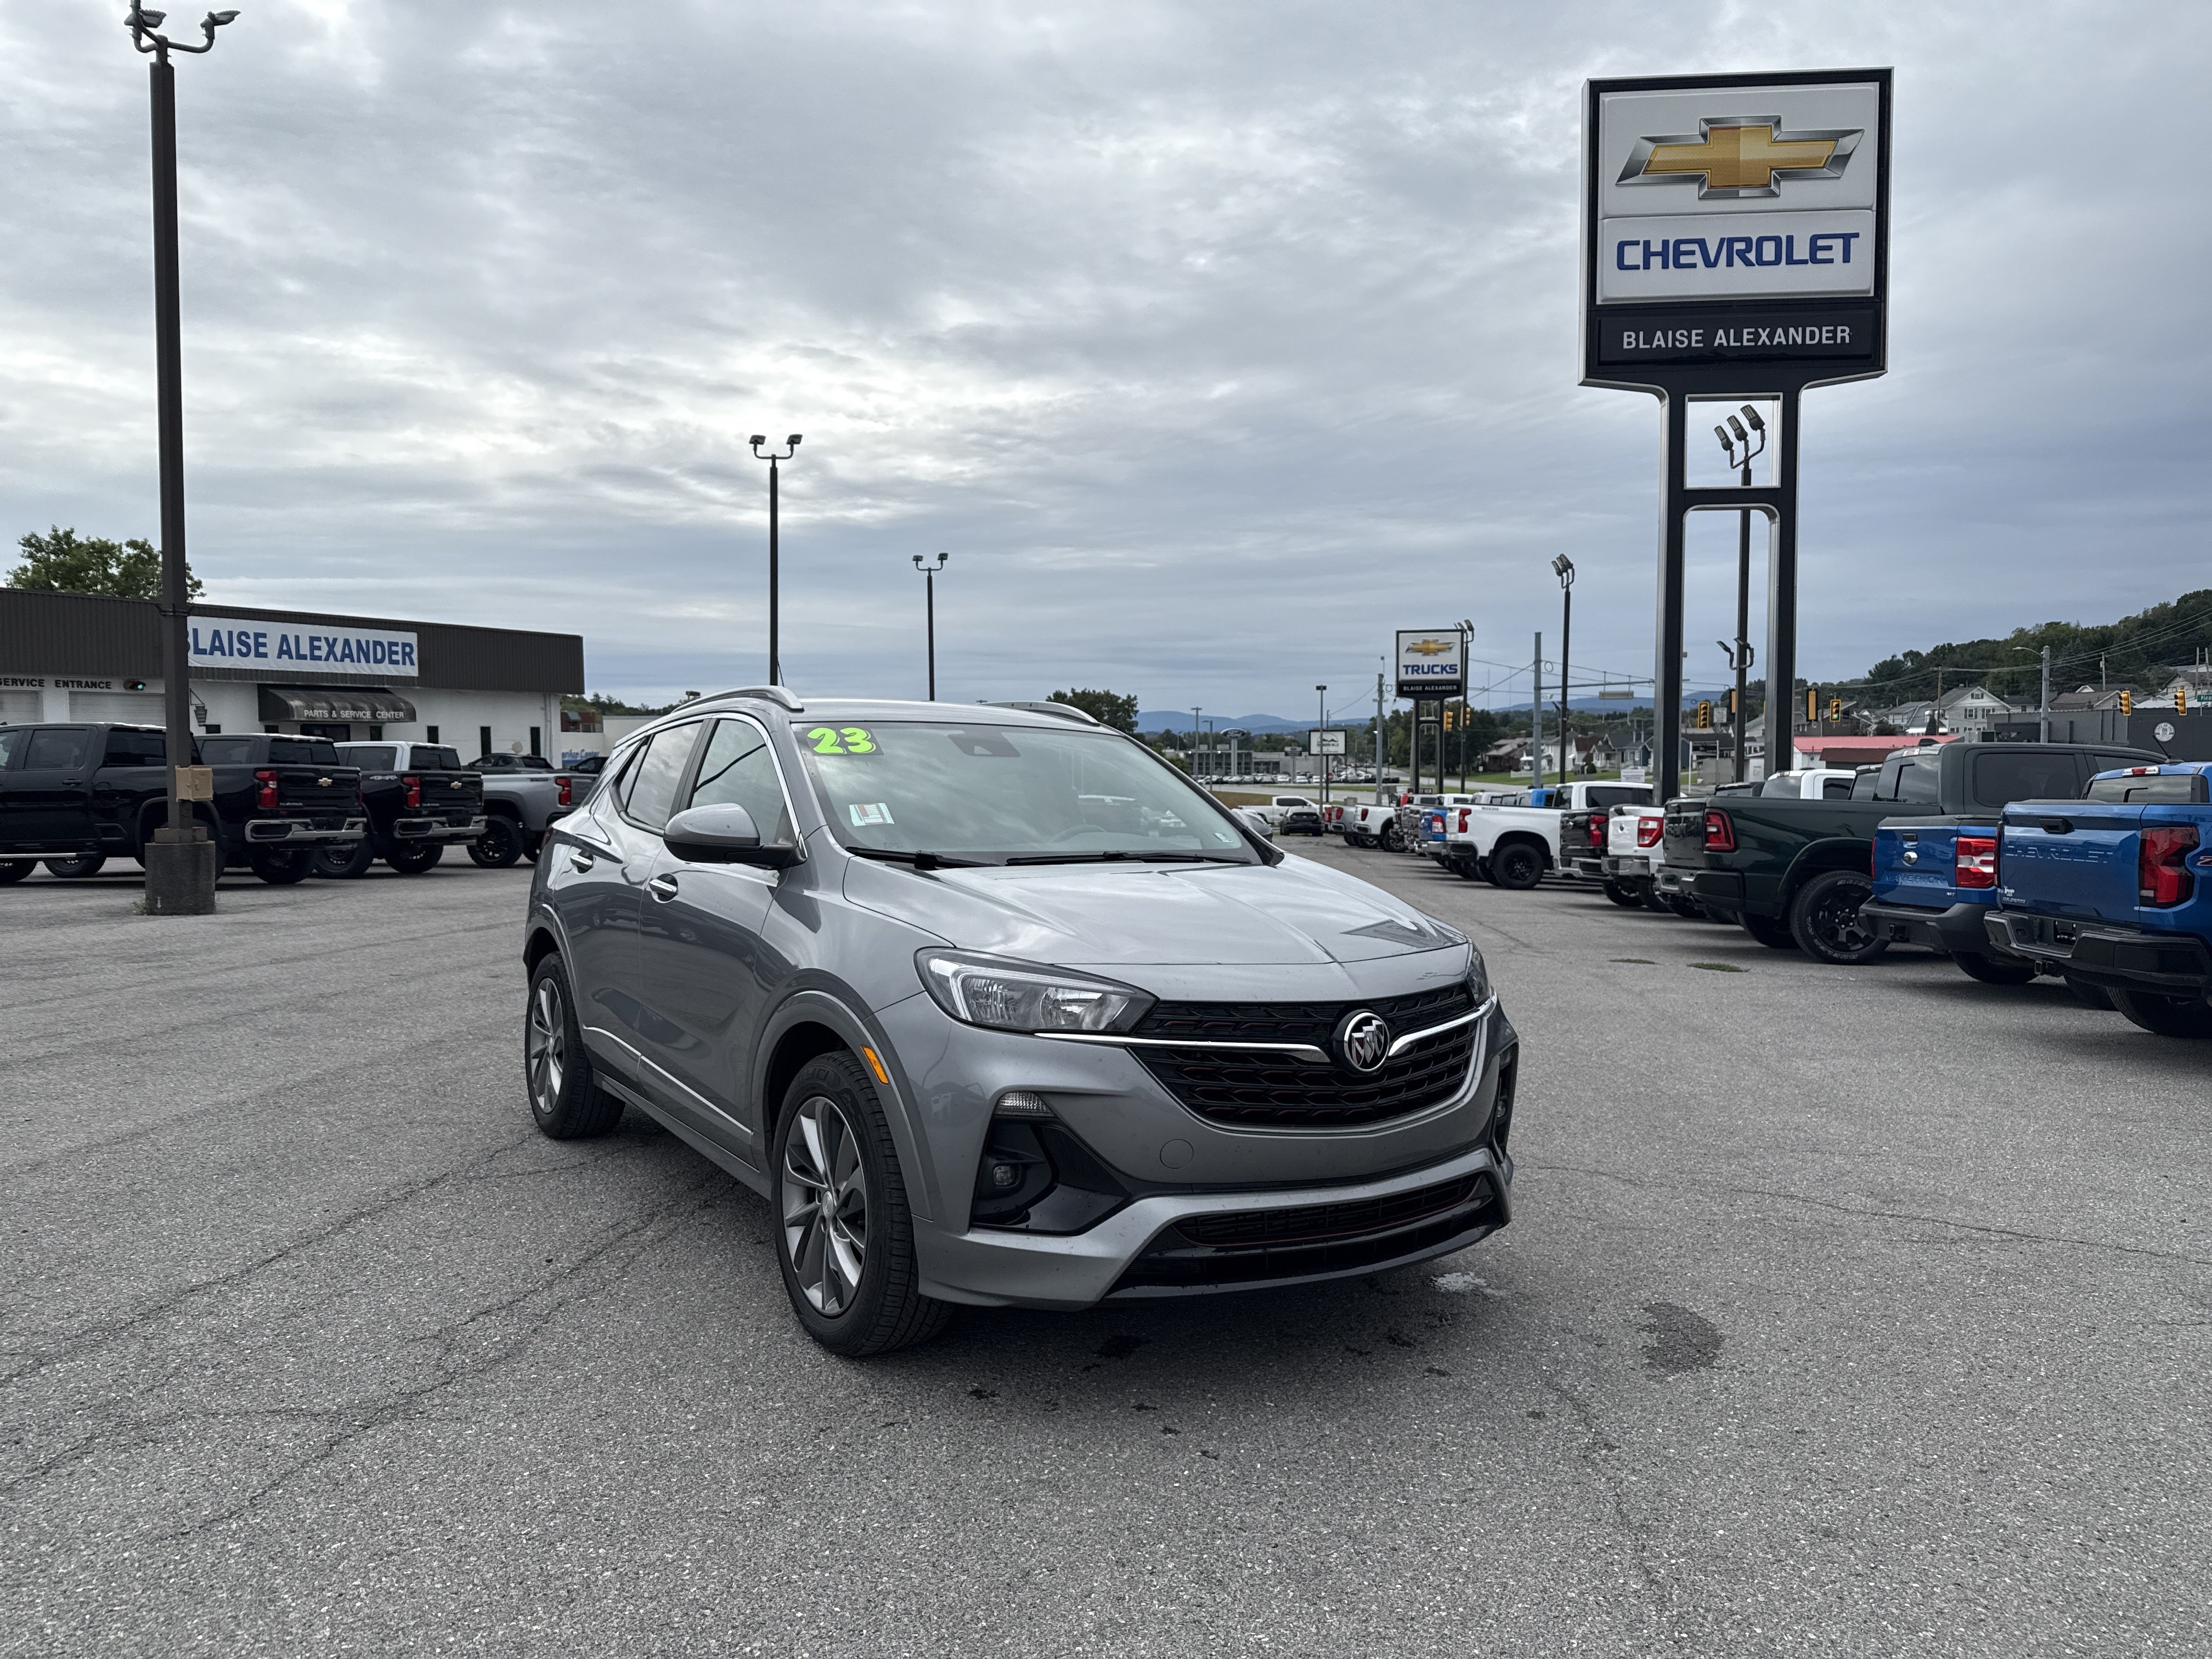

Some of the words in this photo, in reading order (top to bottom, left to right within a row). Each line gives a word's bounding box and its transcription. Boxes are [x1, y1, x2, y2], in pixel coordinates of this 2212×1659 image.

[1616, 232, 1860, 270] CHEVROLET
[1622, 329, 1703, 350] BLAISE
[1713, 325, 1850, 347] ALEXANDER
[187, 628, 268, 658] LAISE
[276, 633, 415, 666] ALEXANDER
[1402, 663, 1458, 675] TRUCKS
[54, 679, 112, 690] ENTRANCE
[303, 709, 329, 718] PARTS
[331, 709, 337, 718] &
[340, 710, 371, 719] SERVICE
[376, 710, 404, 719] CENTER
[807, 727, 876, 754] 23
